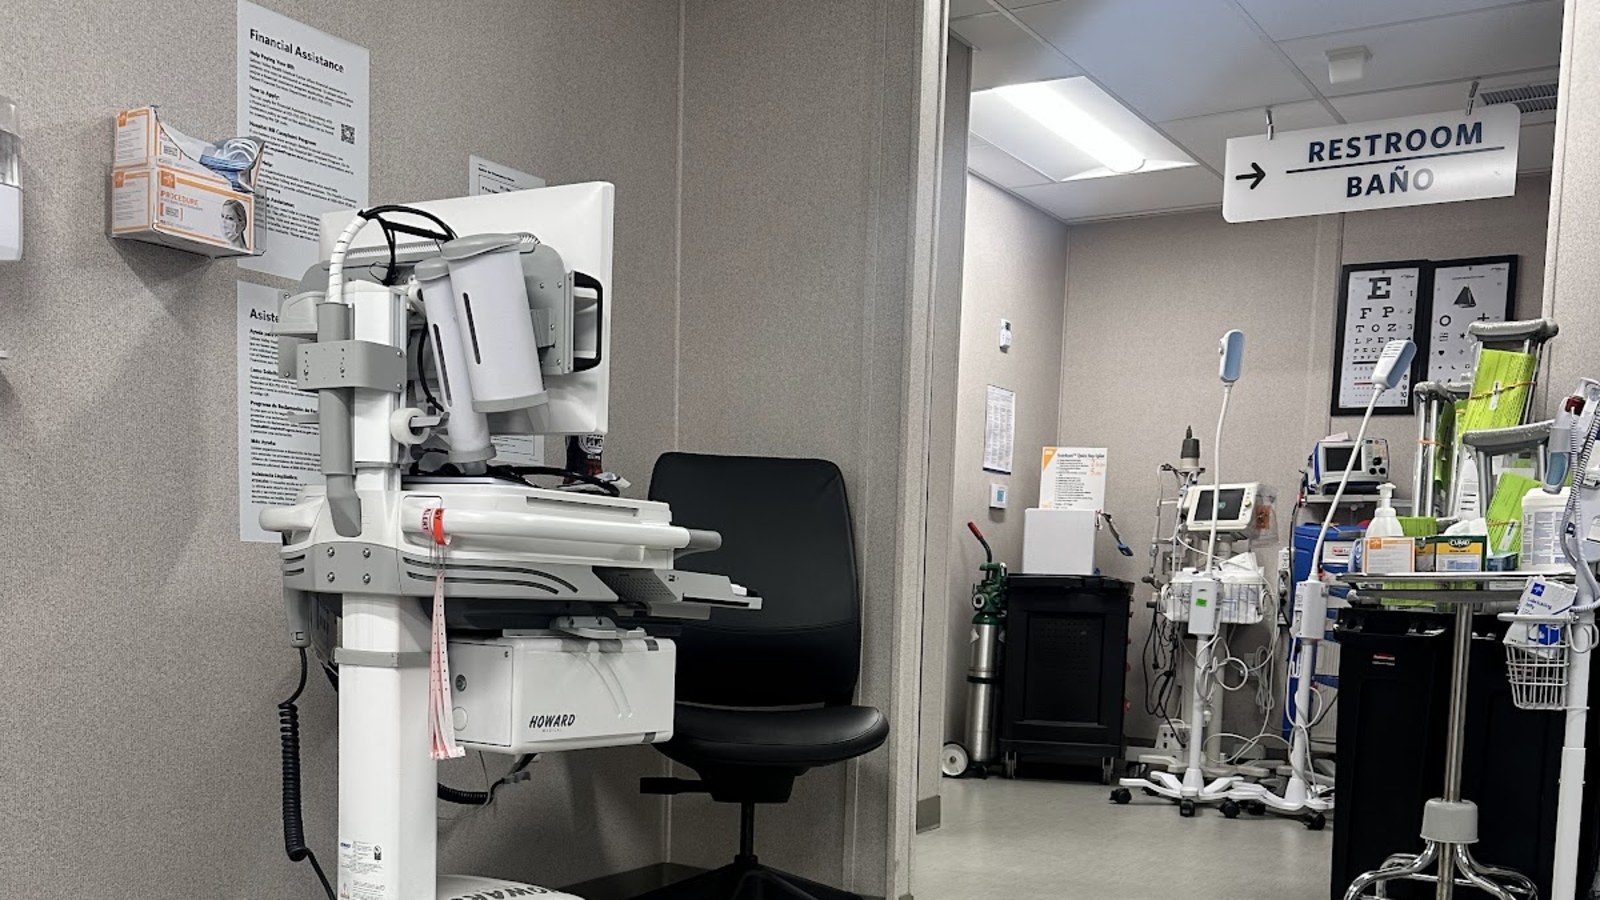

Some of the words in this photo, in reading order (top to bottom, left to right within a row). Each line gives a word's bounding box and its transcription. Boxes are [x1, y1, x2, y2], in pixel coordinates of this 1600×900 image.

[250, 28, 292, 54] Financial
[294, 46, 344, 74] Assistance
[1308, 121, 1482, 164] RESTROOM
[1346, 164, 1435, 198] BAÑO
[1367, 276, 1392, 300] E
[1360, 308, 1372, 319] F
[1382, 306, 1394, 318] P
[1356, 324, 1365, 333] T
[1371, 324, 1380, 332] O
[1387, 323, 1397, 332] Z
[529, 714, 576, 728] HOWARD
